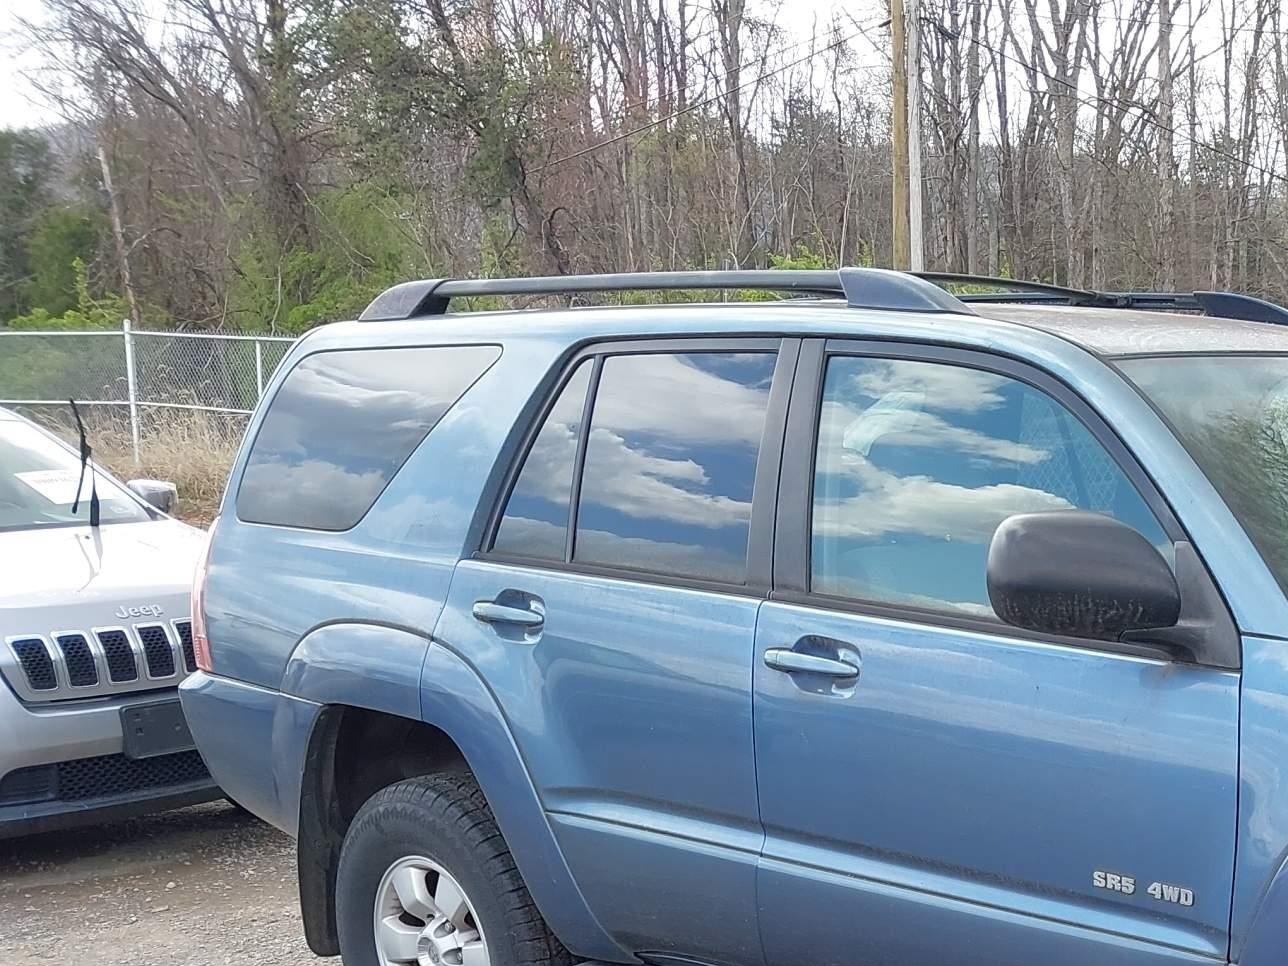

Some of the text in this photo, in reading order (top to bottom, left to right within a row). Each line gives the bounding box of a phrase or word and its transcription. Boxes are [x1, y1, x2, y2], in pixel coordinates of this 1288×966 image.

[115, 605, 163, 619] Jeep
[1092, 871, 1194, 906] SR5 4WD
